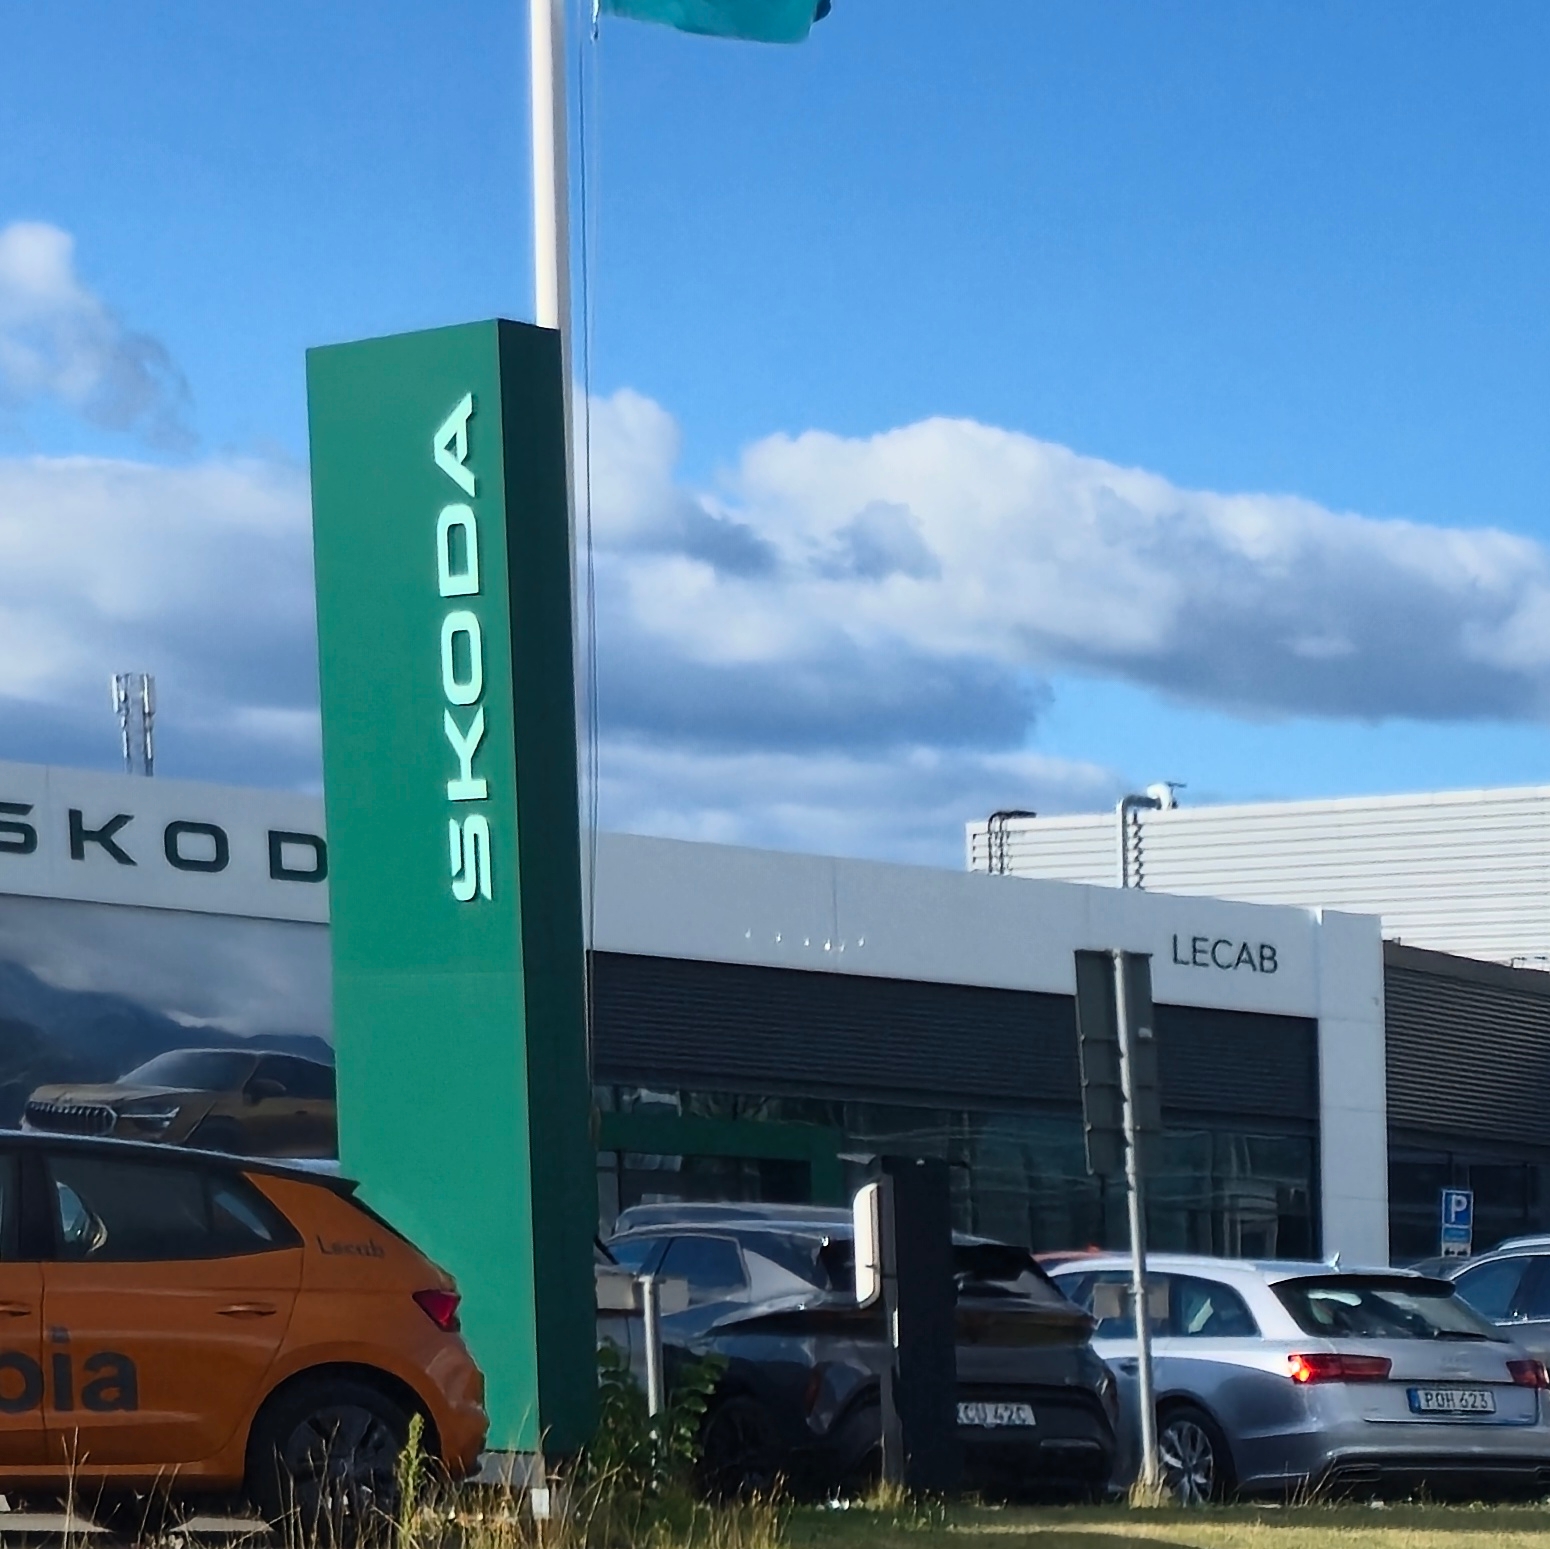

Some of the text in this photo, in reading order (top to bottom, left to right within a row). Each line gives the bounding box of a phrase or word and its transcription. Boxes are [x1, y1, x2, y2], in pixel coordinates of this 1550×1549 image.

[433, 392, 492, 901] SKODA
[0, 801, 329, 883] SKOD
[1172, 934, 1278, 974] LECAB
[1451, 1194, 1467, 1223] P
